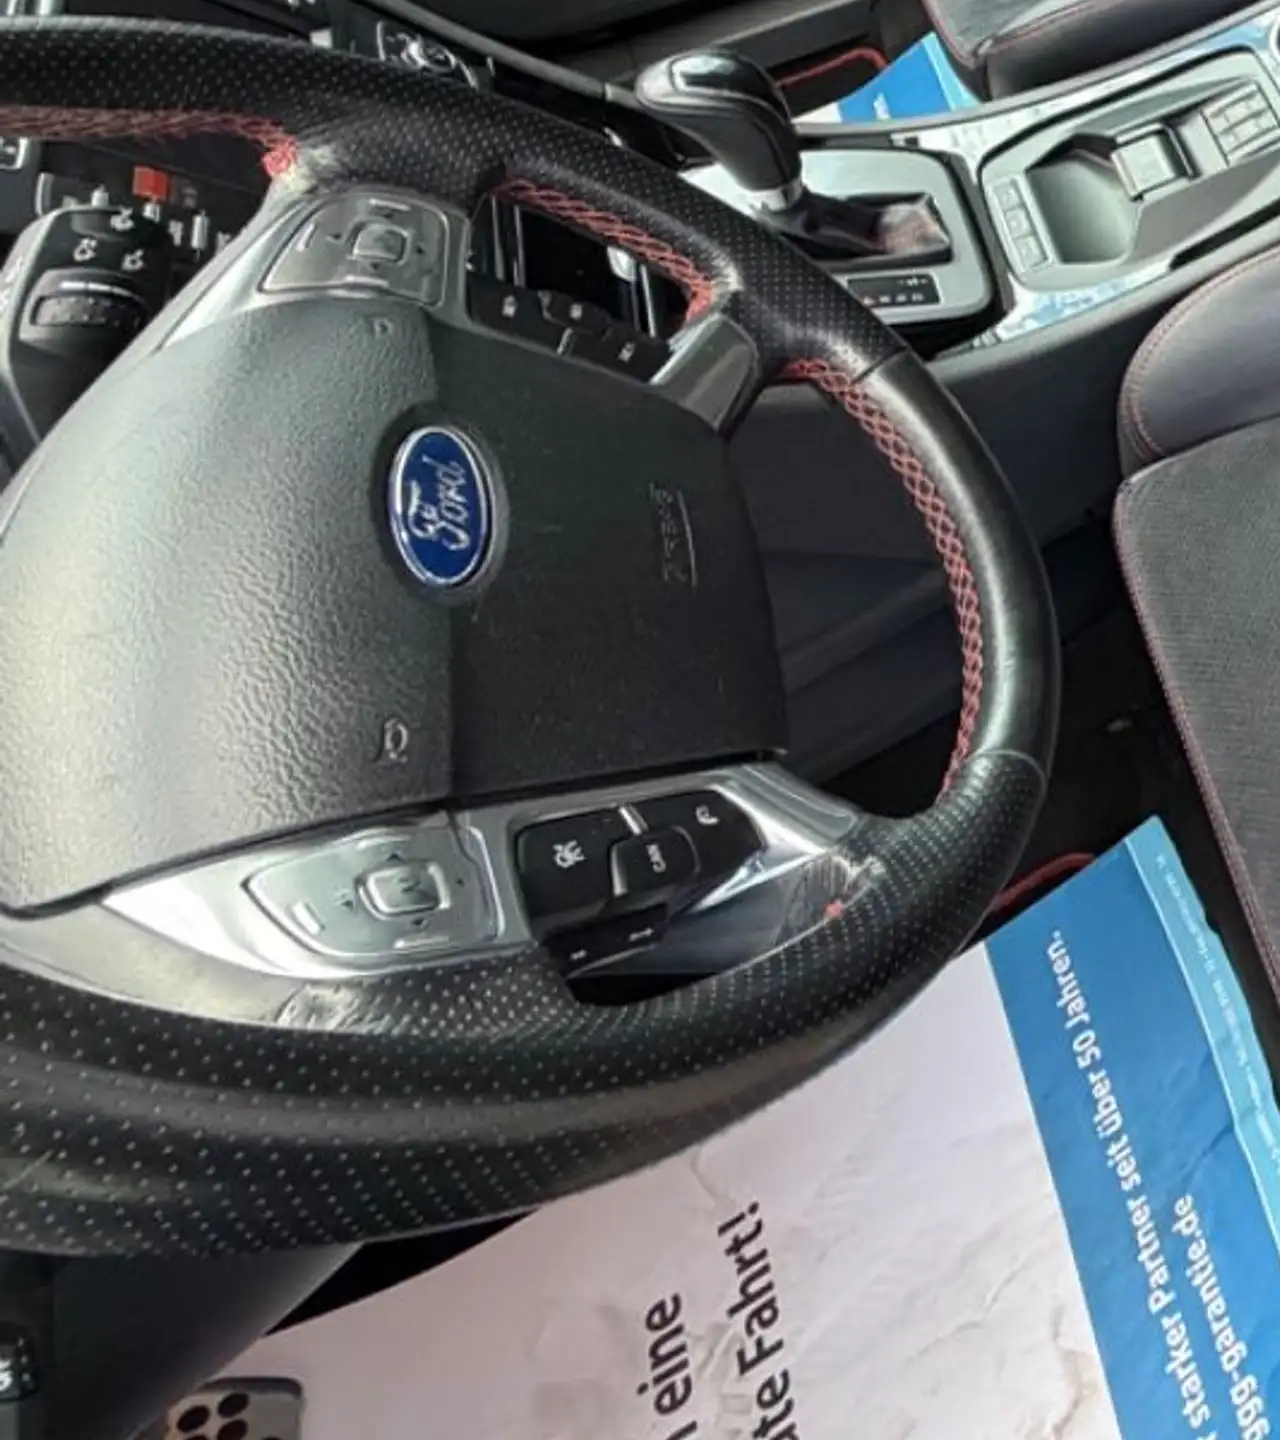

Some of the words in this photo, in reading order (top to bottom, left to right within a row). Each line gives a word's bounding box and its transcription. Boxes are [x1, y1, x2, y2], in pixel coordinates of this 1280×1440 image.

[408, 455, 470, 550] Ford
[1047, 929, 1091, 1030] Jahren.
[1072, 1029, 1101, 1069] 50
[1088, 1068, 1123, 1139] über
[1106, 1133, 1141, 1191] seit
[717, 1201, 784, 1376] Fahrt!
[1127, 1195, 1176, 1314] Partner
[636, 1292, 692, 1416] eine
[1160, 1312, 1211, 1429] starker
